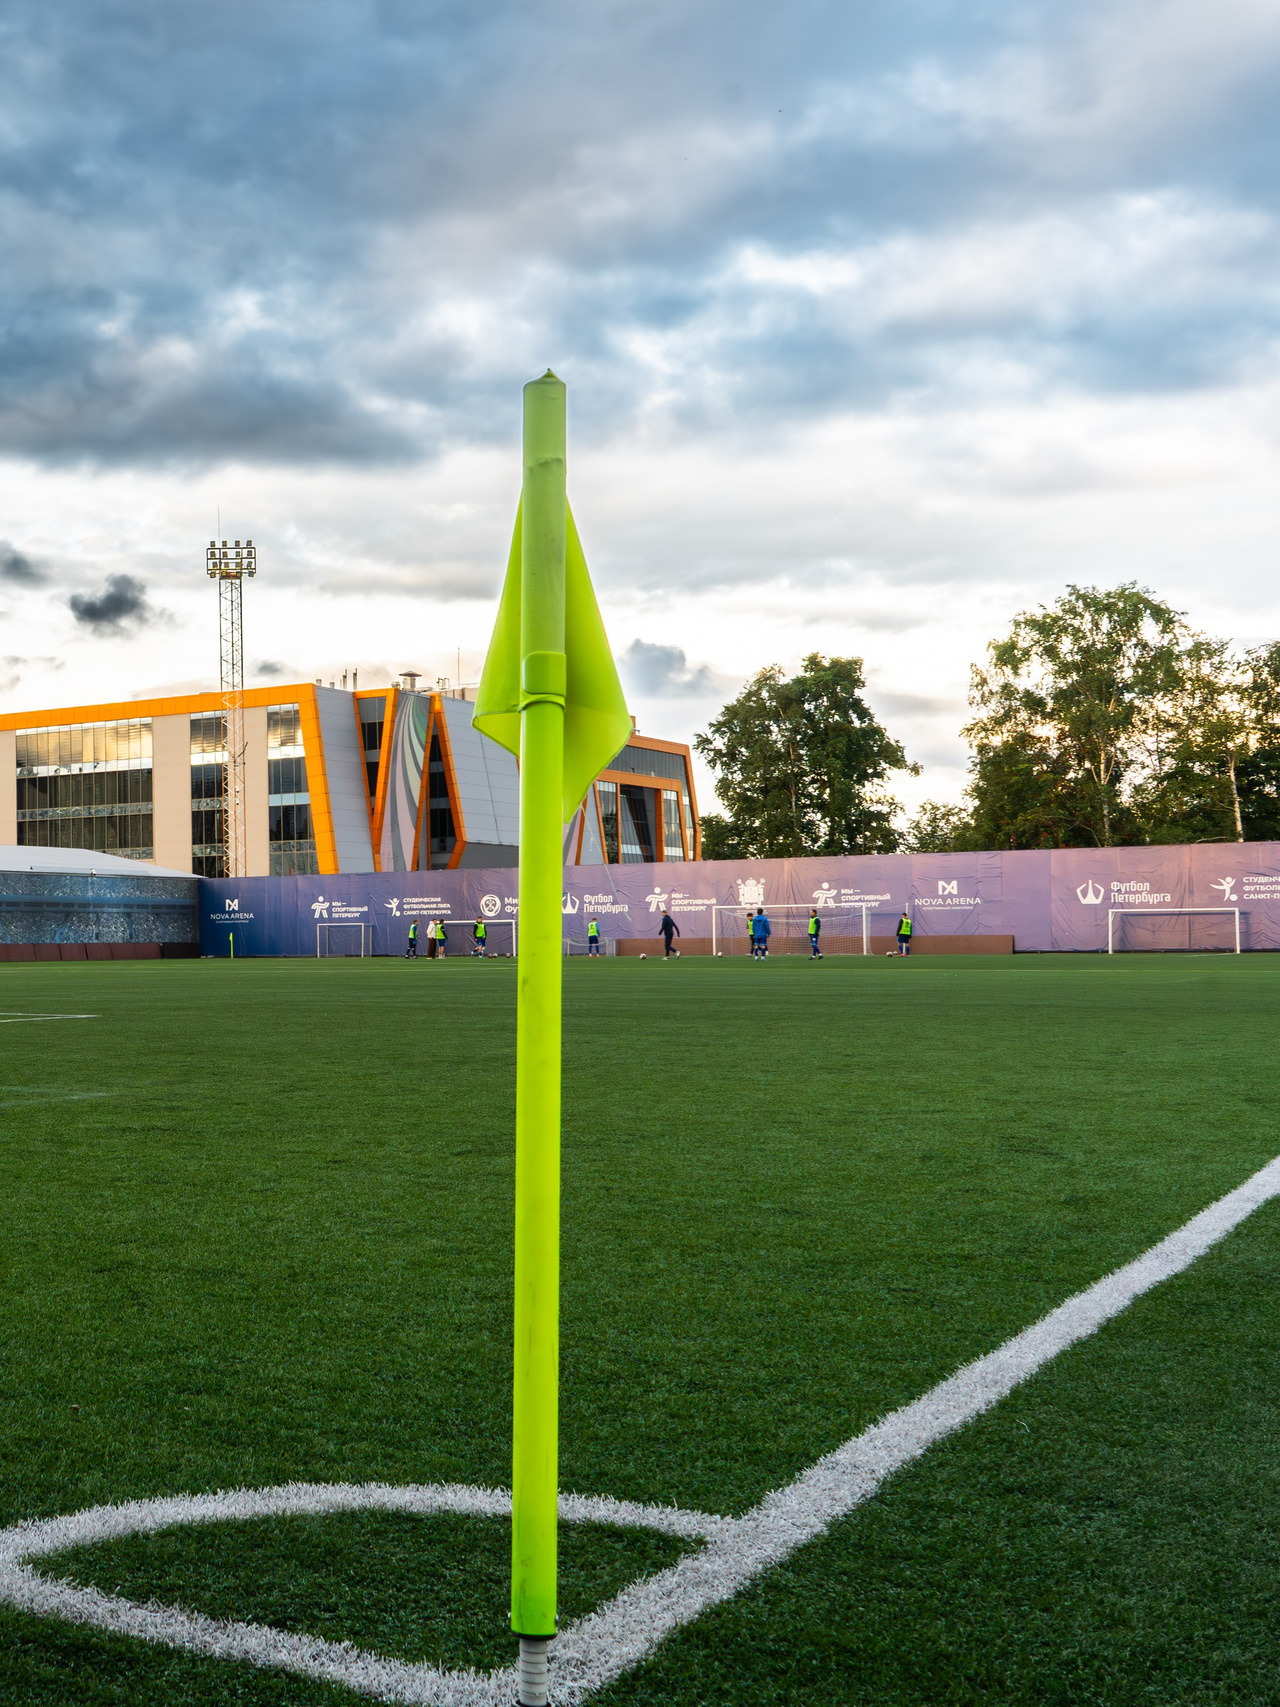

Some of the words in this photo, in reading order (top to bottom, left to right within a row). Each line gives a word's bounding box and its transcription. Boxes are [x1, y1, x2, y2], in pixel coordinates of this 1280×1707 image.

[1110, 881, 1150, 894] Футбол
[583, 893, 613, 904] Футбол
[841, 893, 891, 901] СПОРТИВНЫЙ
[945, 897, 981, 905] ARENA
[1110, 891, 1171, 905] Петербурга
[583, 903, 629, 915] Петербурга
[230, 912, 254, 920] ARENA
